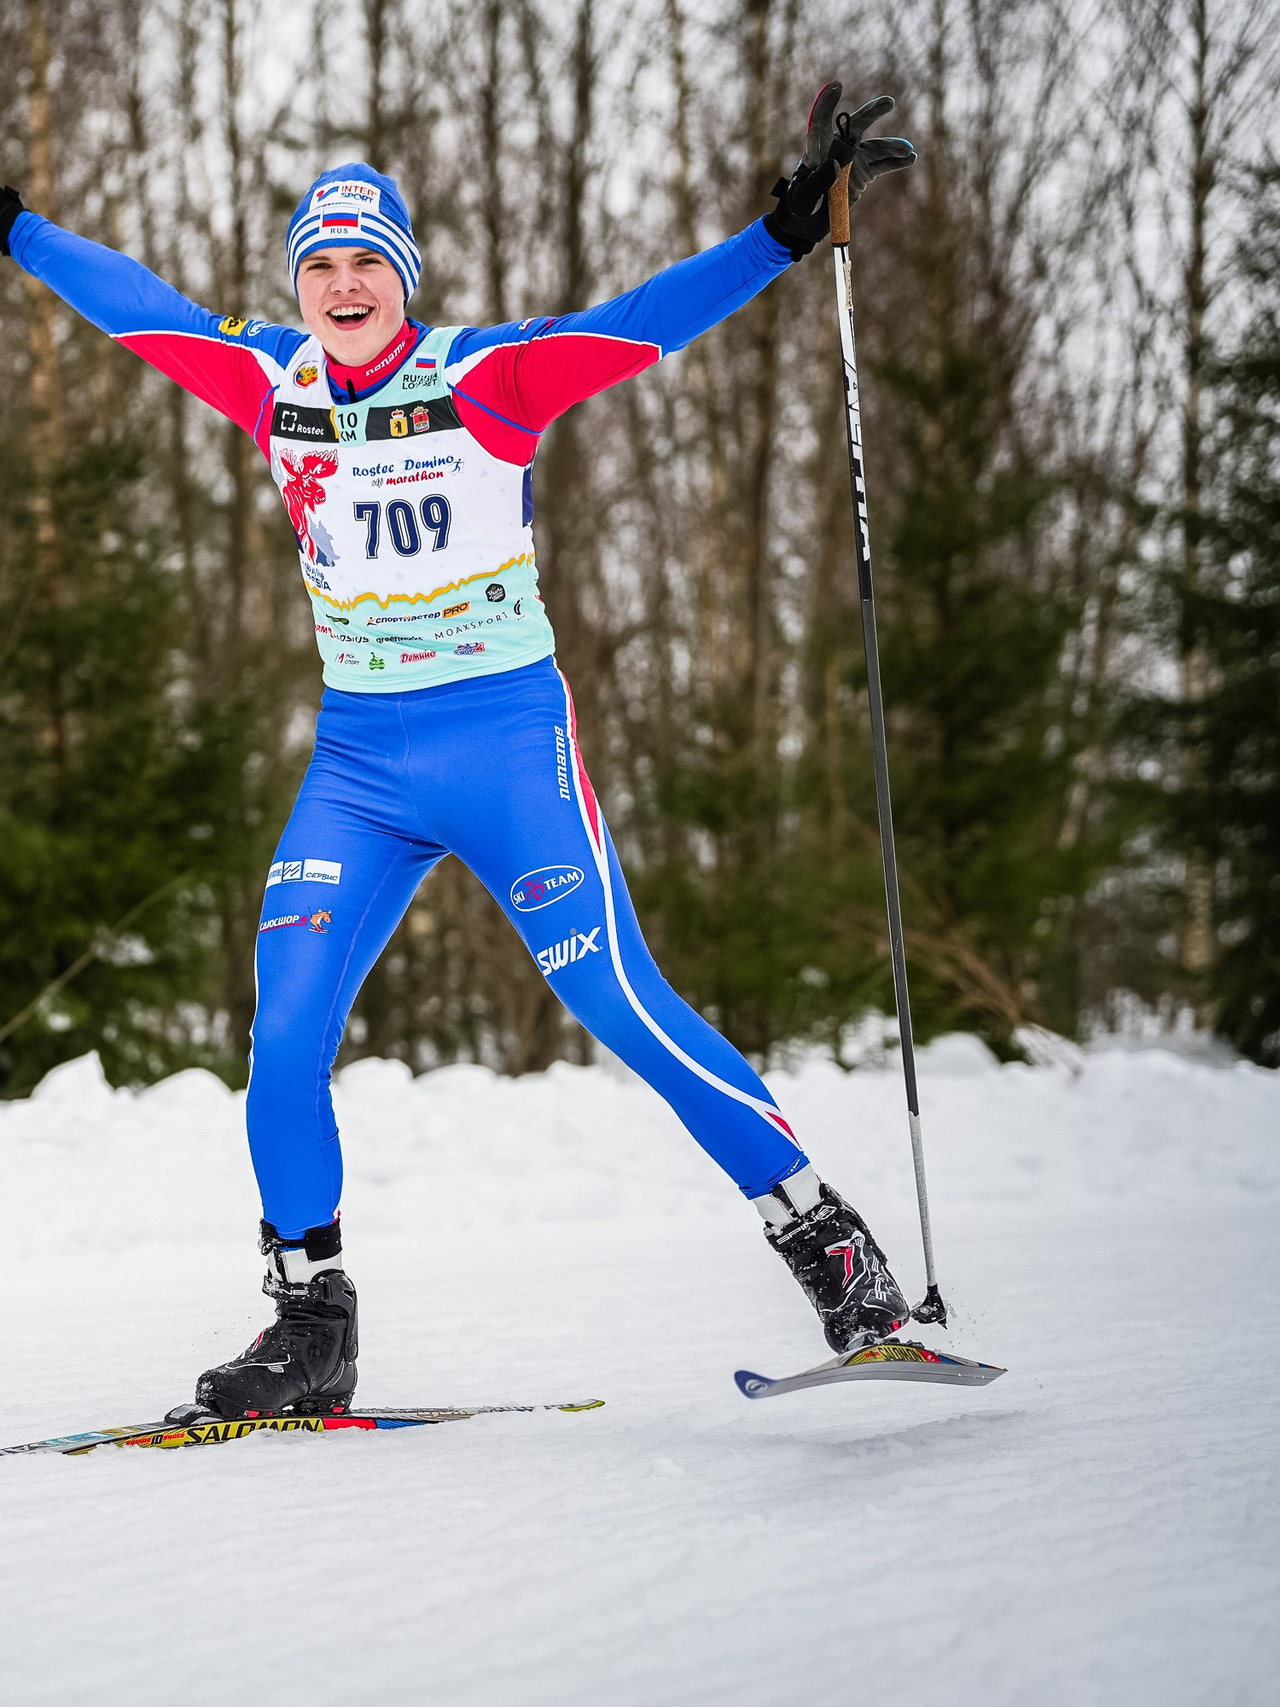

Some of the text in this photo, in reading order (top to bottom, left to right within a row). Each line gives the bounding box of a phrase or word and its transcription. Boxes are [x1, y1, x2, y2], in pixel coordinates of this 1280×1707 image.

[341, 185, 375, 197] INTER
[337, 412, 358, 429] 10
[297, 424, 325, 436] Rostec
[352, 455, 454, 477] Rostec Demino
[385, 470, 444, 486] marathon
[352, 493, 453, 560] 709
[443, 602, 469, 618] PRO
[554, 725, 571, 802] noname
[513, 871, 580, 905] SKI 76 TEAM
